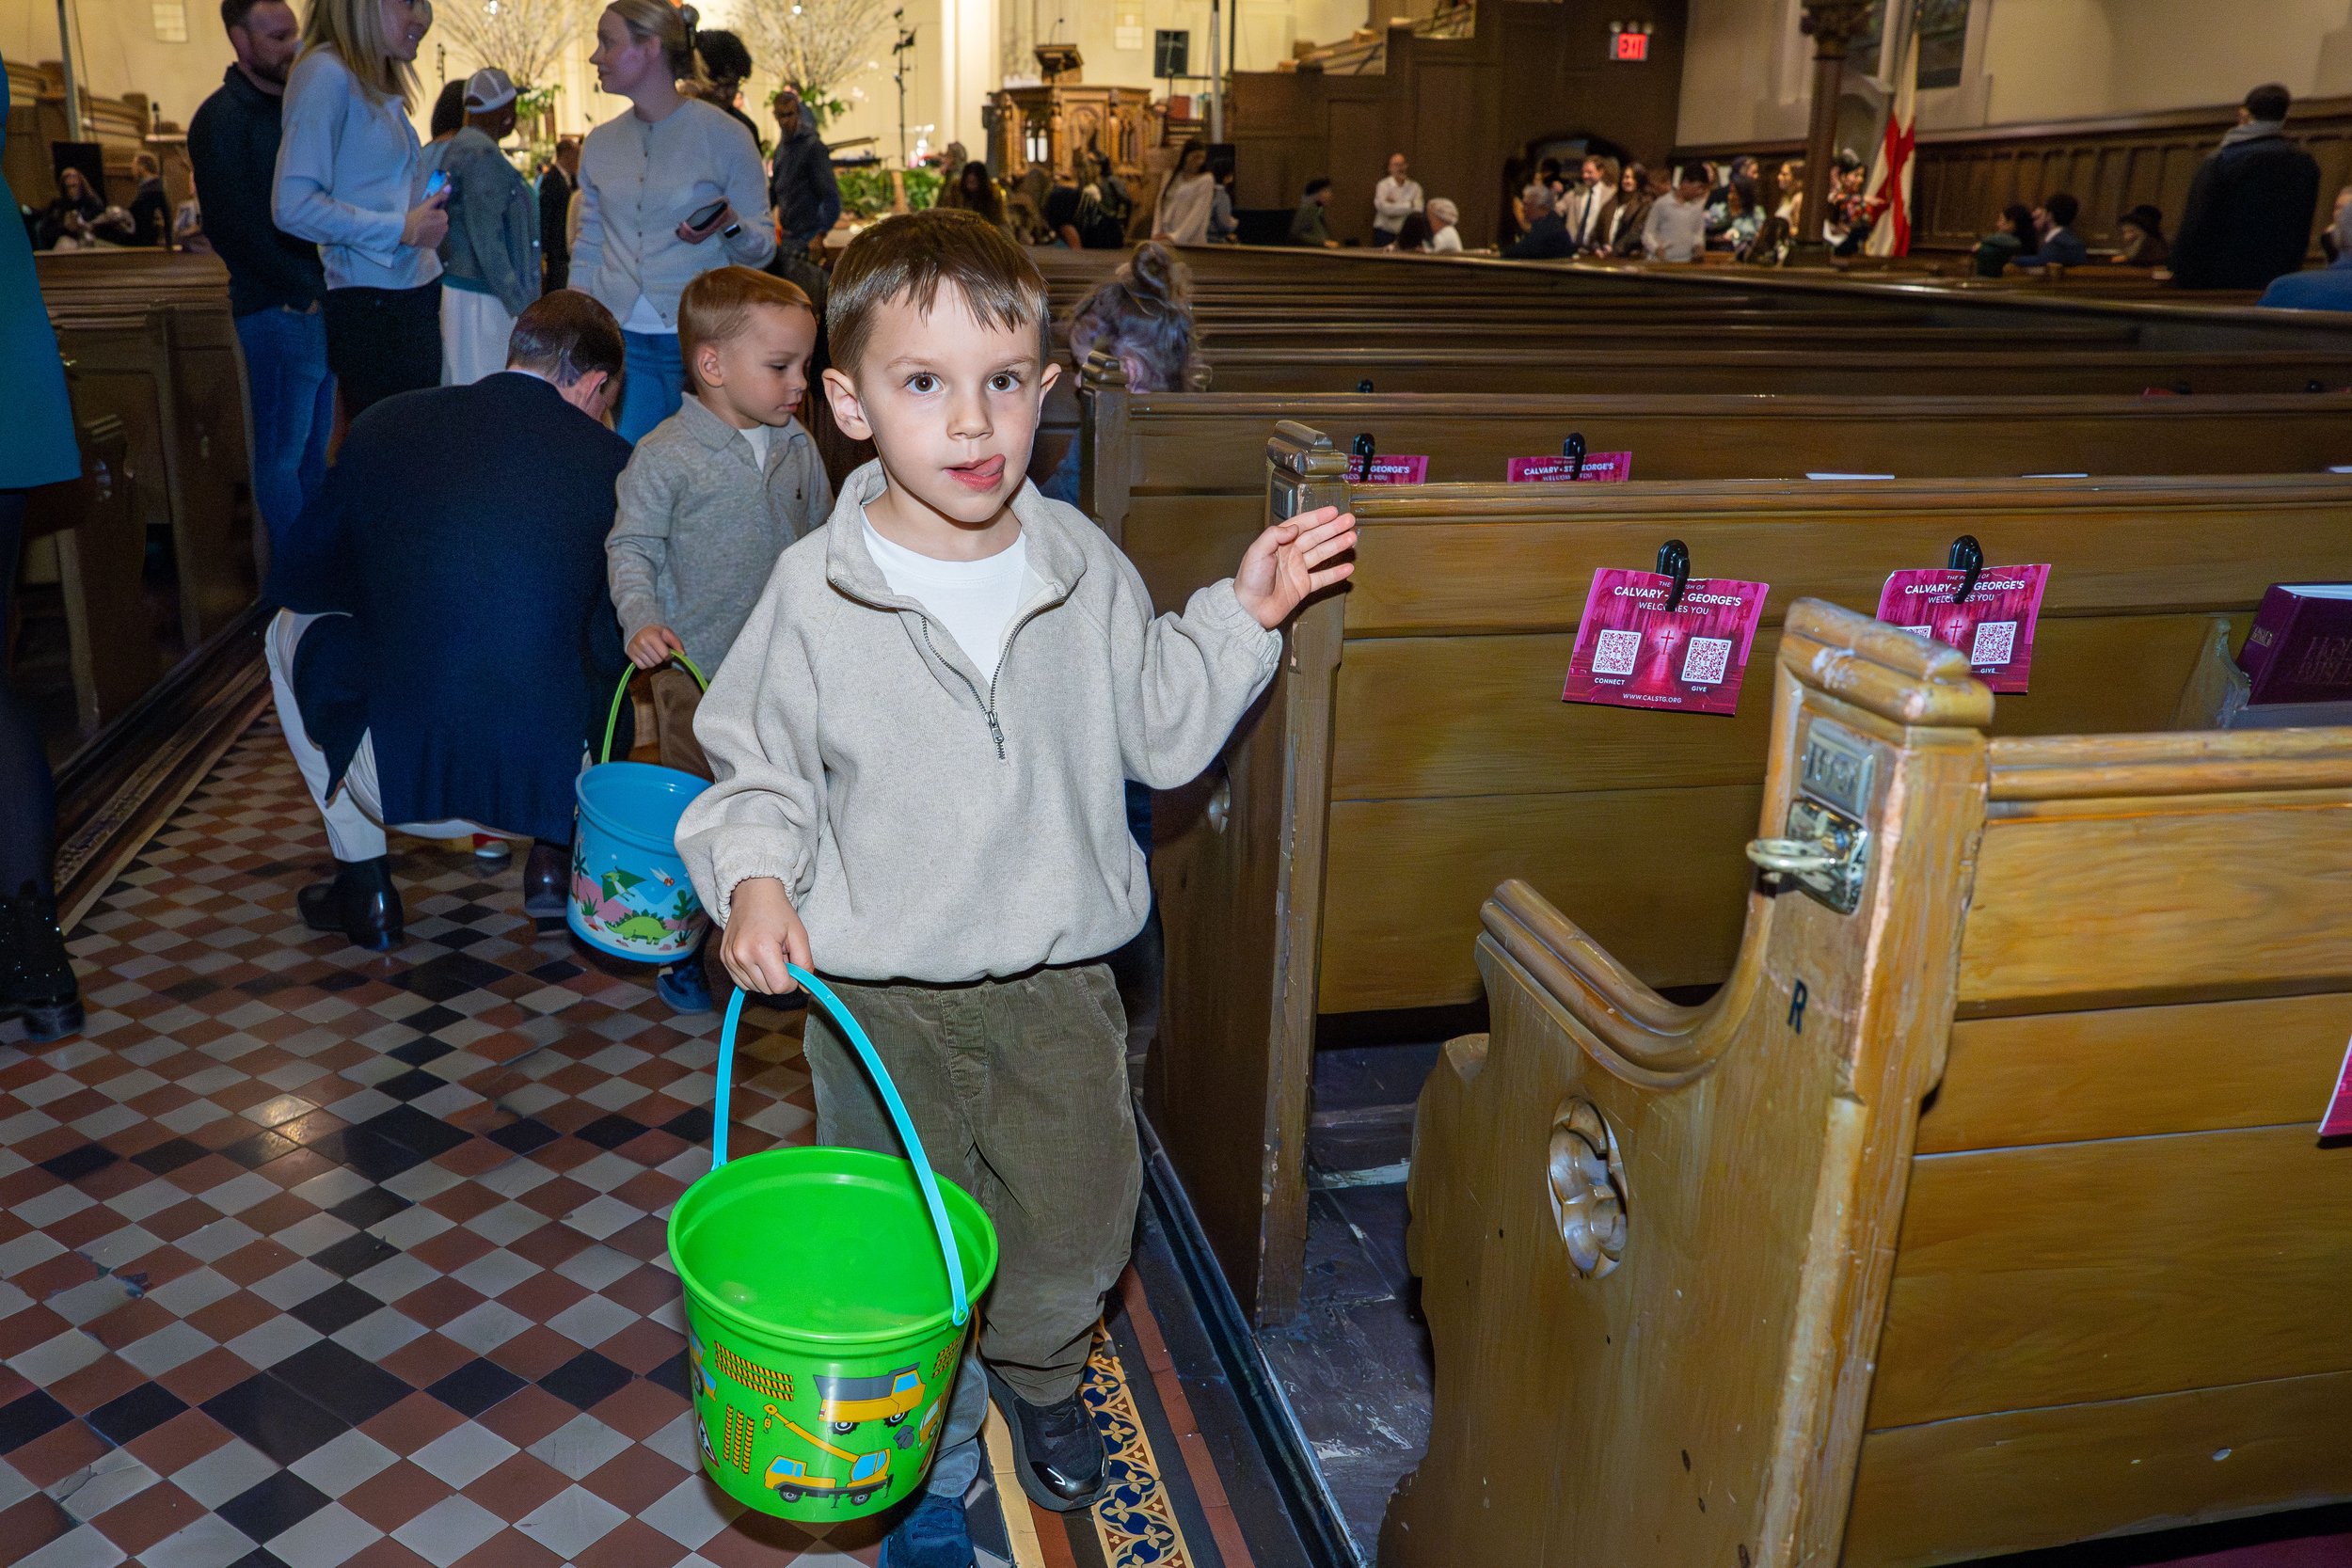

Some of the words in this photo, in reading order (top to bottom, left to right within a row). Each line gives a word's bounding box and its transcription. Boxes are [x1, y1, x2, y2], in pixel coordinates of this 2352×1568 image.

[1619, 35, 1645, 58] EXIT
[1370, 465, 1410, 474] GEORGE'S
[1524, 466, 1559, 476] CALVARY
[1581, 462, 1614, 471] EORGE'S
[1904, 583, 1952, 594] CALVARY
[1973, 579, 2026, 591] GEORGE'S
[1614, 586, 1664, 599] CALVARY
[1687, 593, 1742, 607] GEORGE'S
[1977, 594, 1994, 602] YOU
[1638, 601, 1689, 613] WELCES
[1691, 607, 1709, 615] YOU
[1594, 677, 1626, 686] CONNECT
[1623, 692, 1682, 704] WWW.CALSTG.ORG
[1788, 978, 1808, 1035] R
